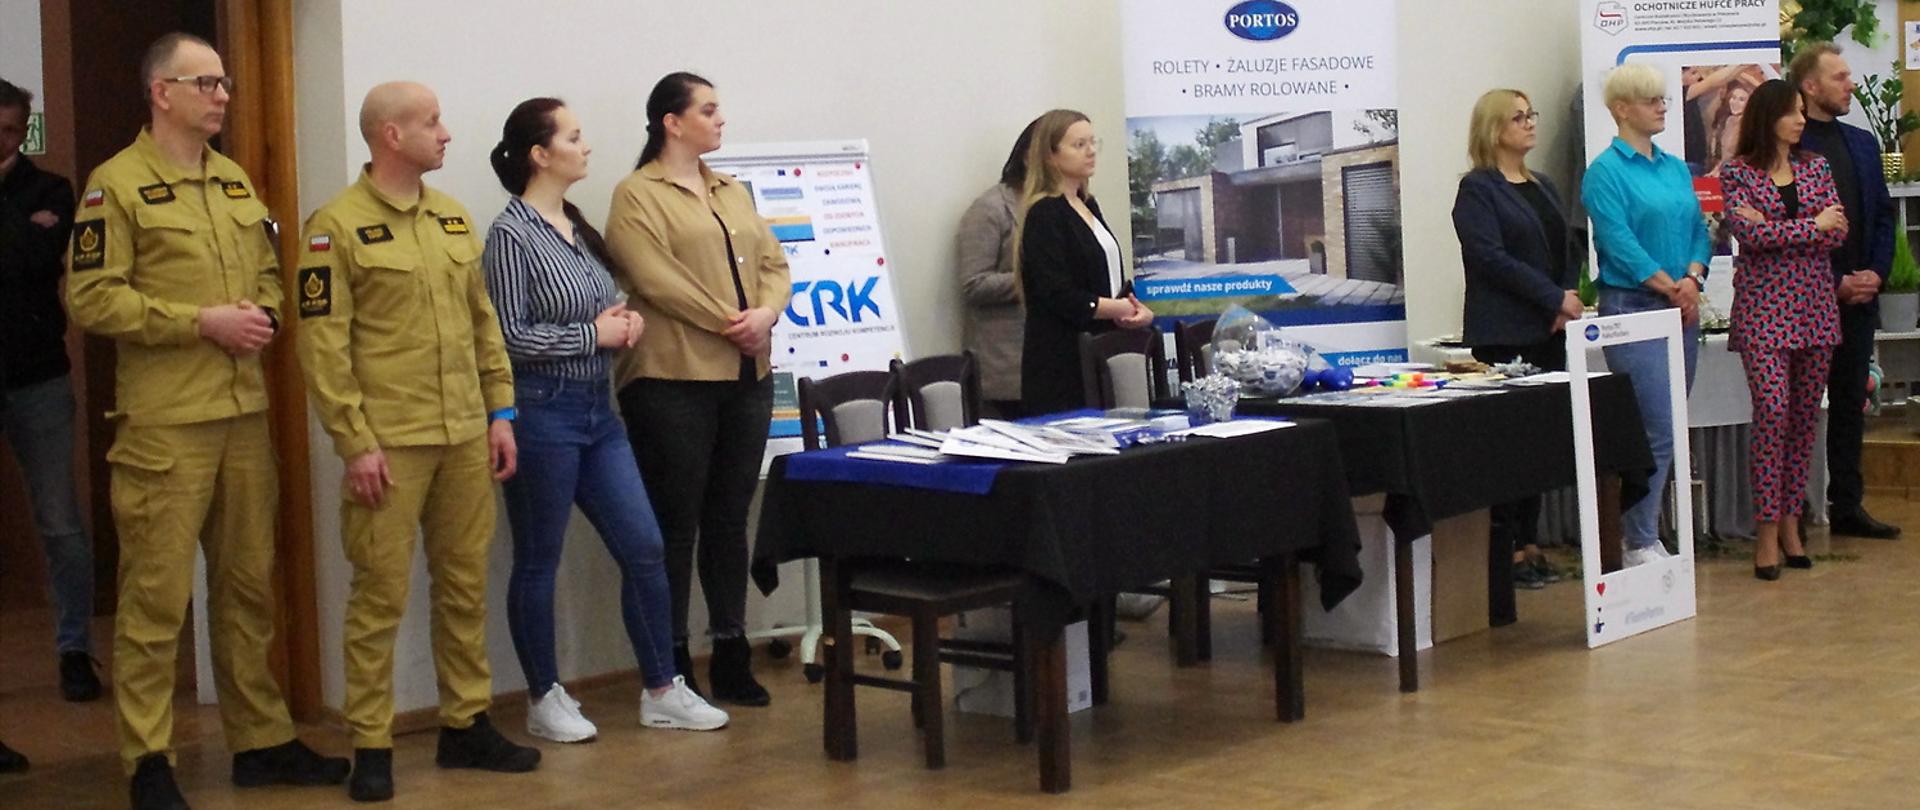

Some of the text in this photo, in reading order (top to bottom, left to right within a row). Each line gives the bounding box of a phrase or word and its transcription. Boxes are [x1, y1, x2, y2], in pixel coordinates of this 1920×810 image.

[1634, 0, 1766, 12] OCHOTNICZE HUFCE PRACY
[1229, 13, 1297, 28] PORTOS
[1600, 19, 1624, 28] OHP
[1153, 56, 1374, 74] ROLETY ŻALUZJE FASADOWE
[1194, 80, 1337, 98] BRAMY ROLOWANE
[1146, 279, 1273, 296] sprawdź nasze produkty
[785, 276, 881, 327] CRK
